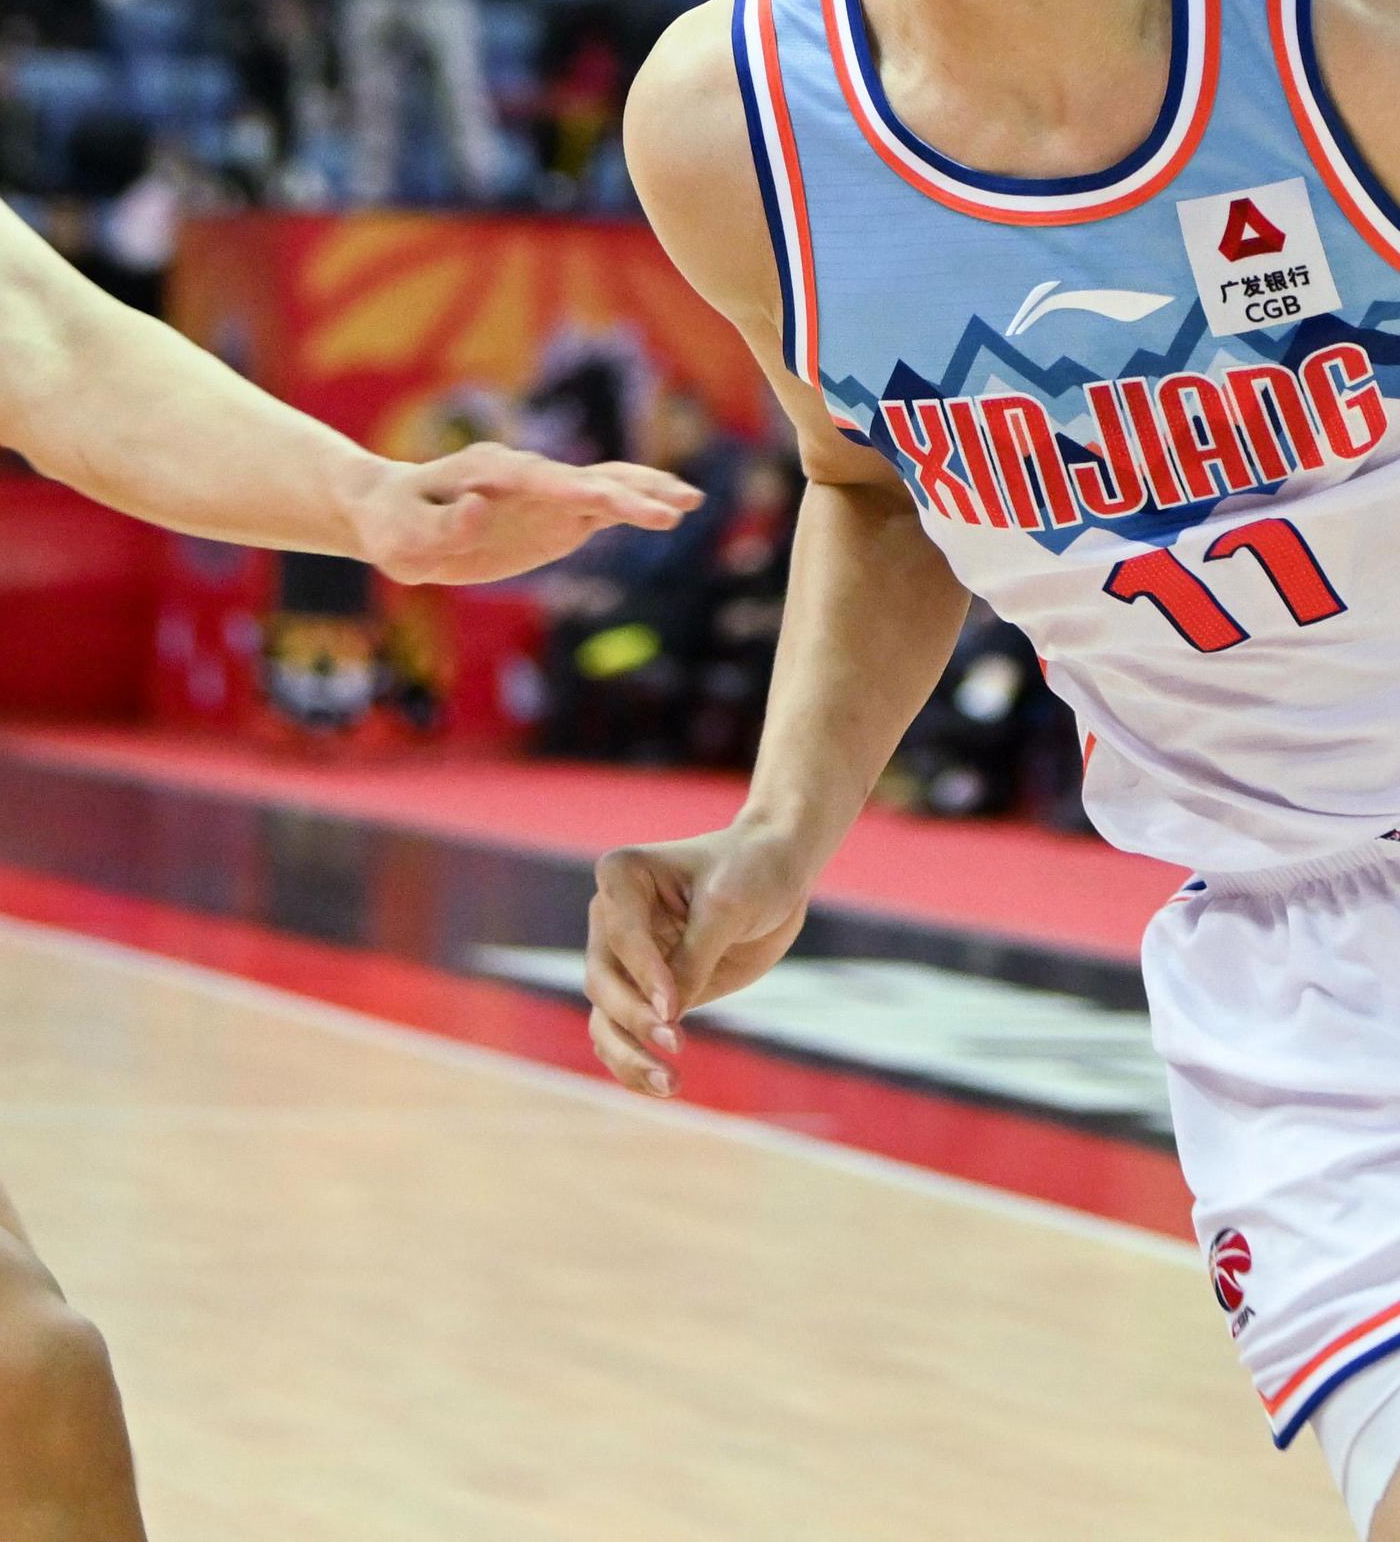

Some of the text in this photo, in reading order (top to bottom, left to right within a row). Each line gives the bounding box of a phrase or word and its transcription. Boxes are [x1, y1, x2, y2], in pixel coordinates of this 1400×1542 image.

[1220, 264, 1310, 304] 广发银行
[1244, 295, 1302, 323] CGB
[879, 341, 1390, 532] XINJIANG
[1102, 517, 1348, 654] 11
